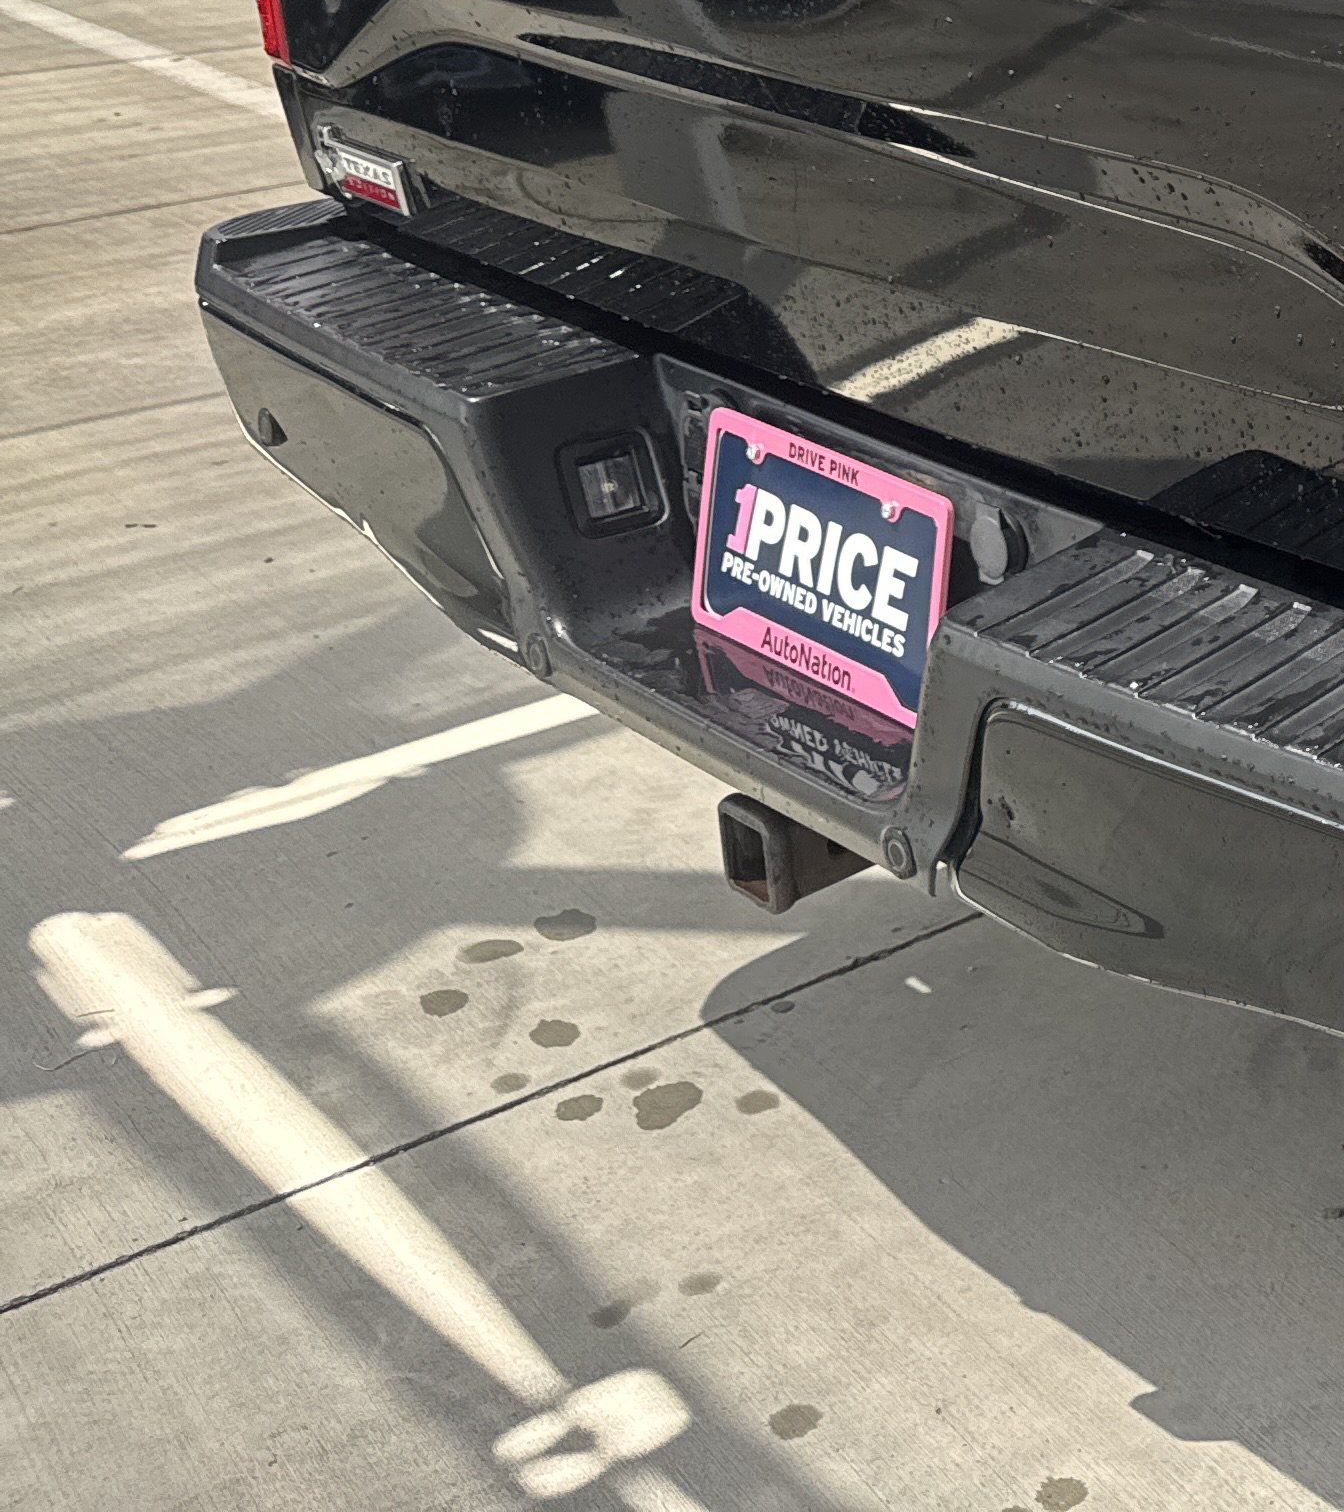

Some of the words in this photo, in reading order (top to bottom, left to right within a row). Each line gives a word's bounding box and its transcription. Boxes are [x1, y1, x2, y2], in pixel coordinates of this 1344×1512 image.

[788, 442, 826, 472] DRIVE
[829, 459, 861, 486] PINK
[720, 551, 818, 615] PRE-OWNED
[821, 599, 907, 659] VEHICLES
[760, 626, 852, 692] AutoNation
